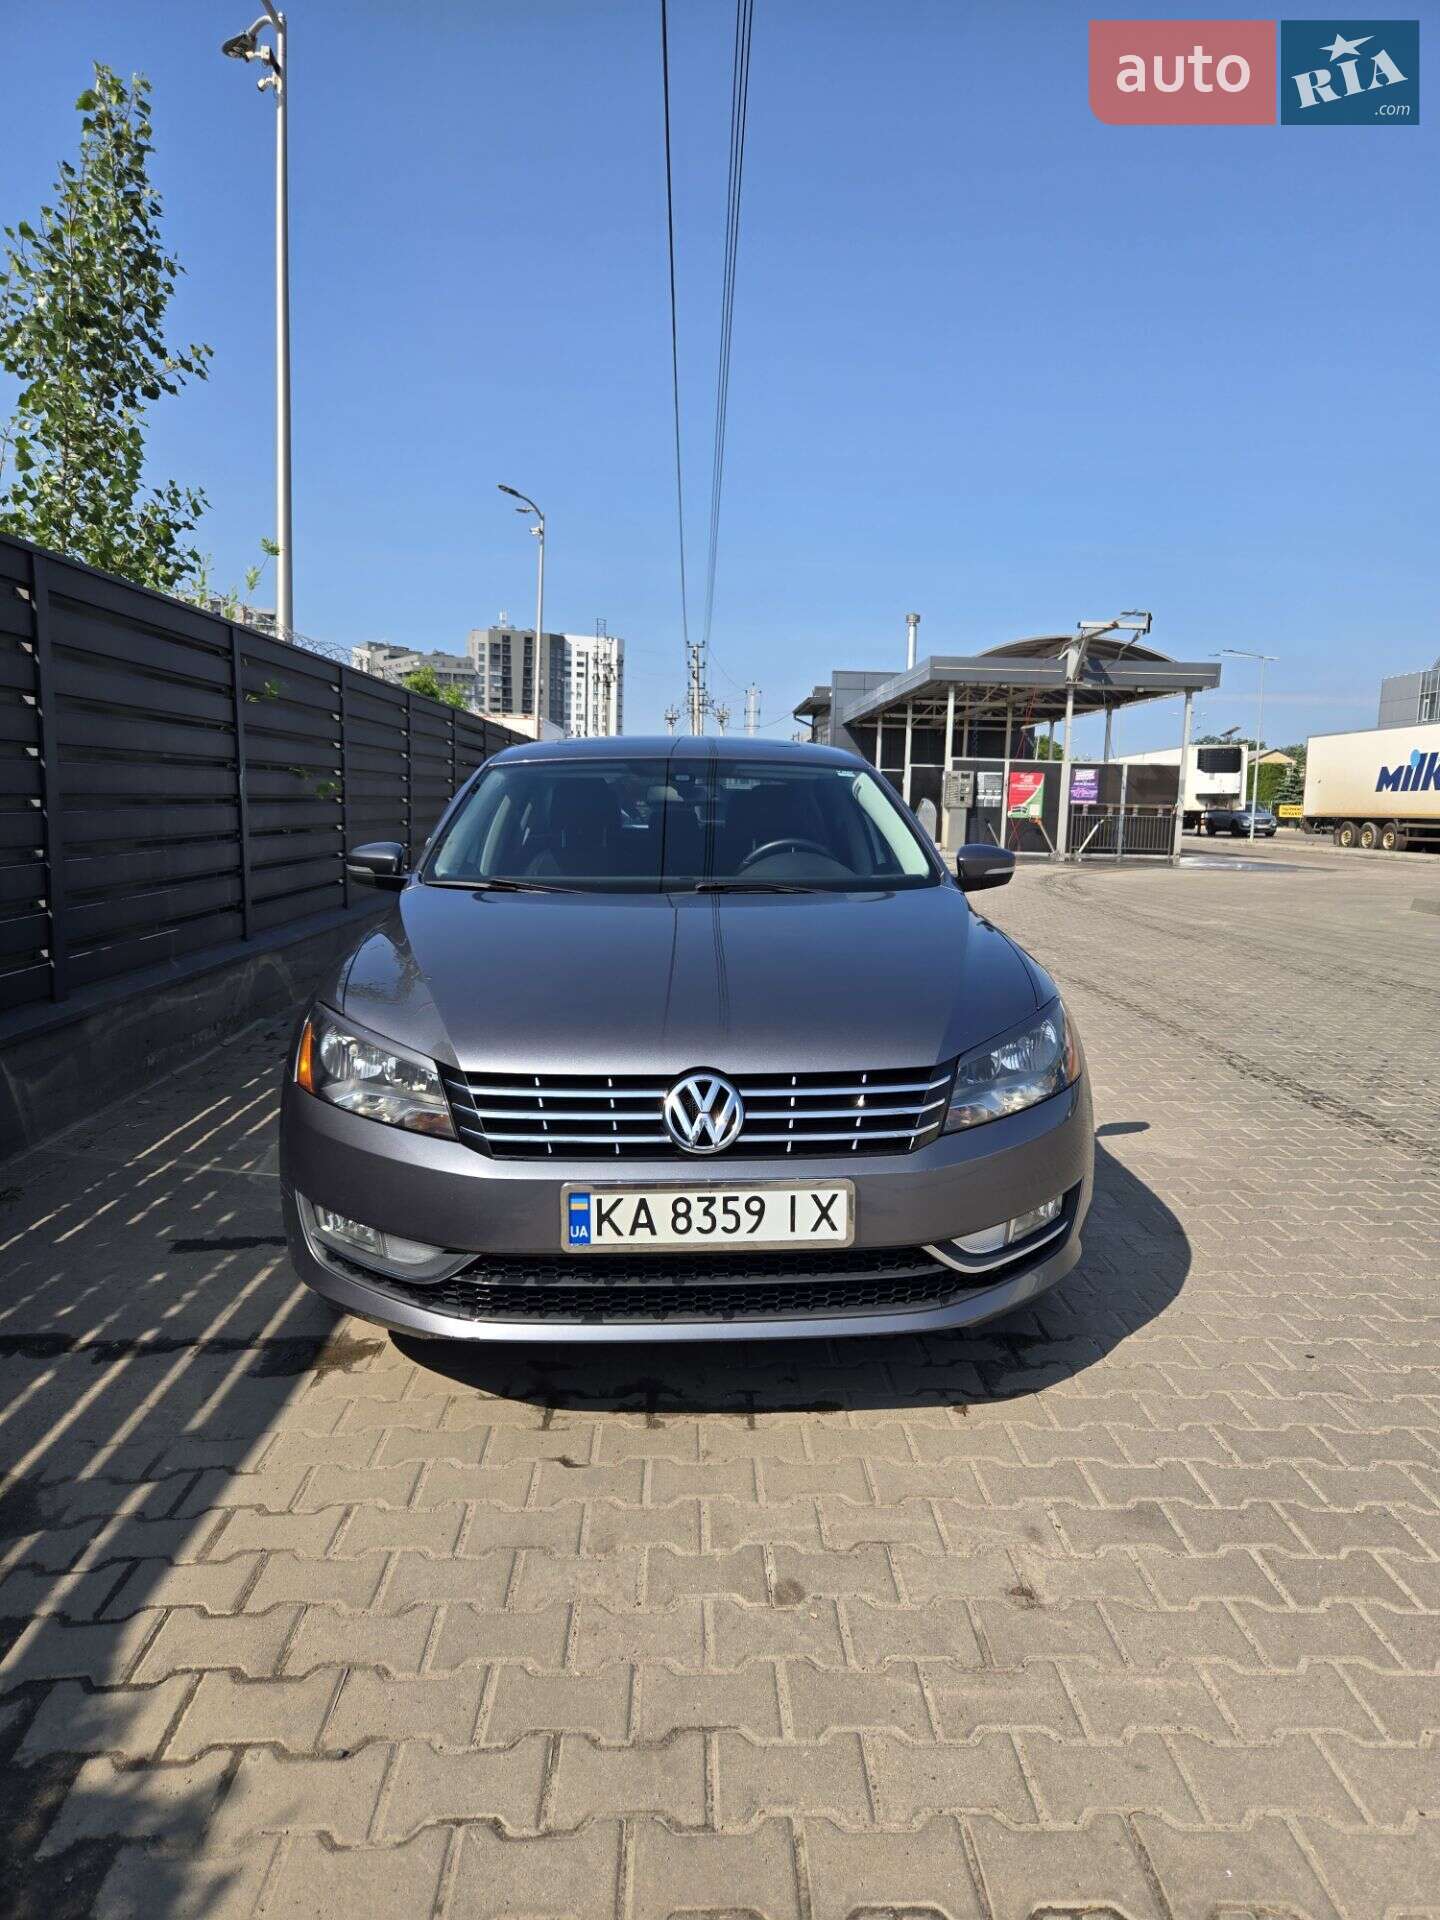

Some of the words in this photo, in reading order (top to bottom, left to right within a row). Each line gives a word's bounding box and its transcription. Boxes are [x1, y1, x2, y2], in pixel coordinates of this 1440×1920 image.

[596, 1197, 657, 1237] KA
[671, 1195, 766, 1235] 8359
[789, 1193, 839, 1233] IX
[570, 1225, 588, 1238] UA
